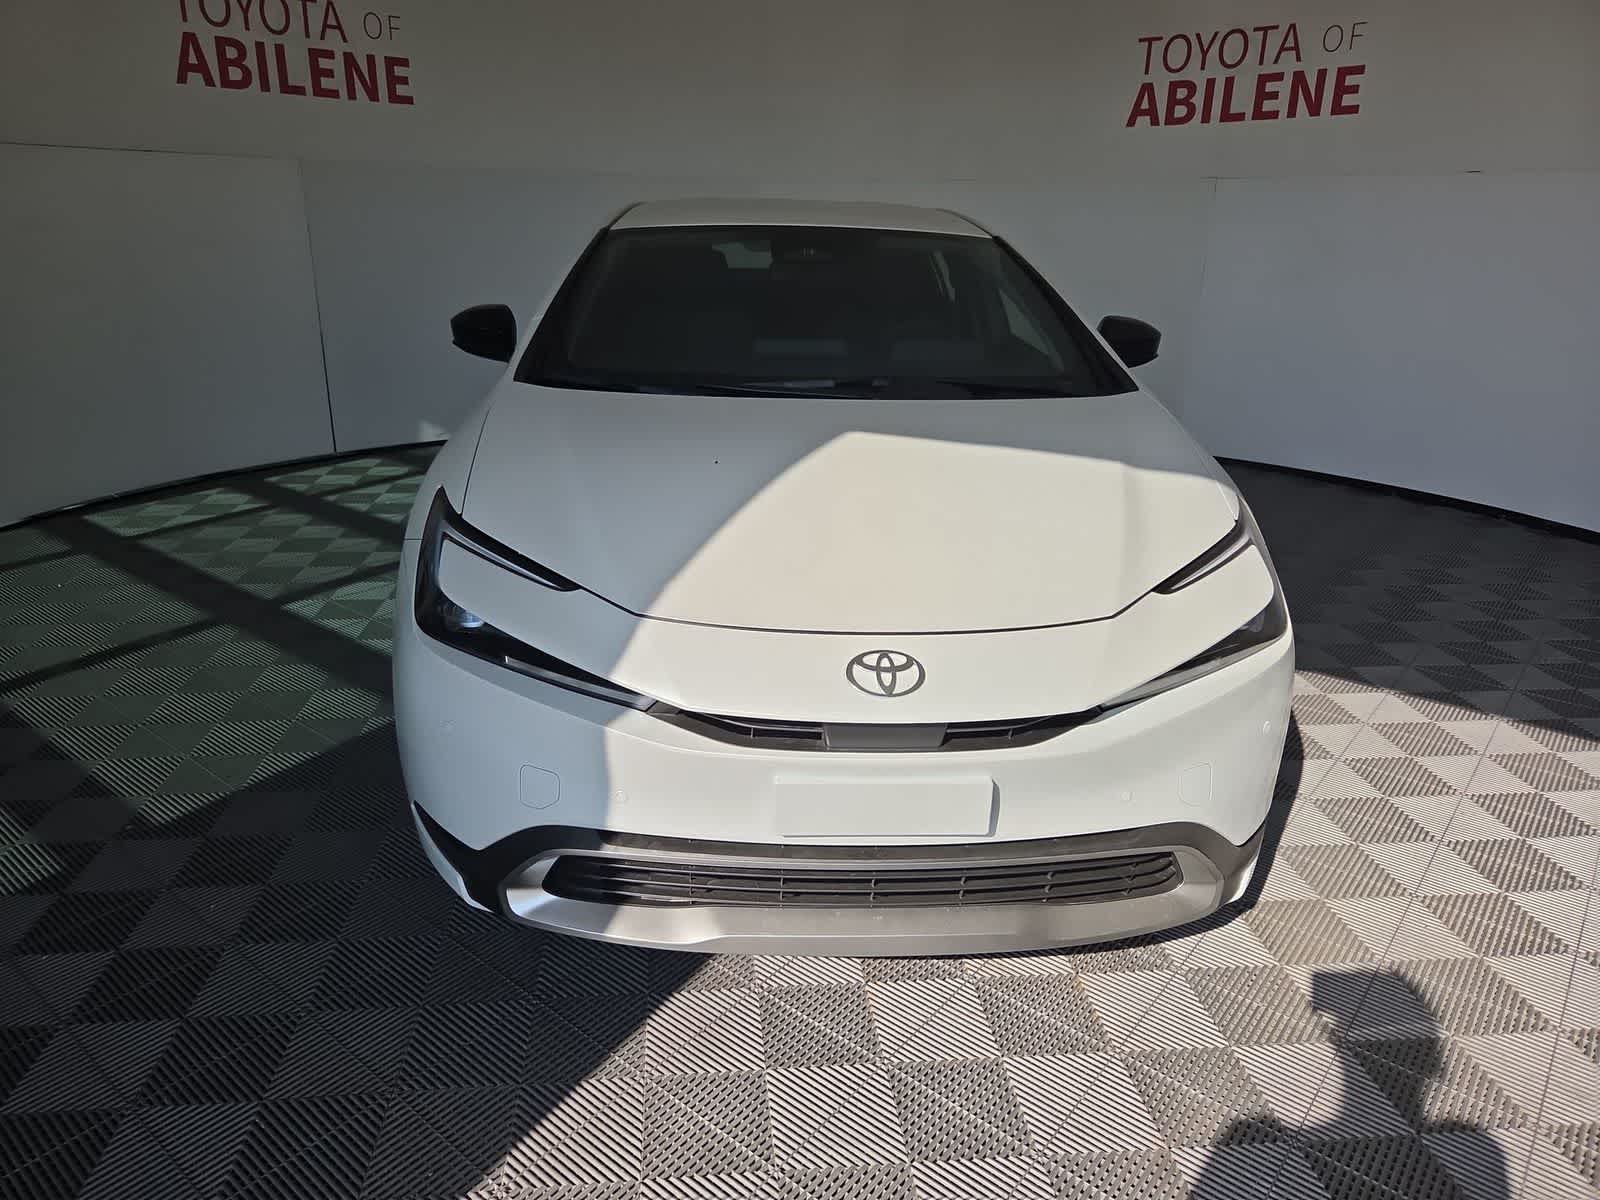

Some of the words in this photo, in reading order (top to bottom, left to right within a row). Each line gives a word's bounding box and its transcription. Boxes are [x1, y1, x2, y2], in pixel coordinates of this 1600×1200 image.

[363, 11, 401, 40] OF
[1138, 23, 1302, 75] TOYOTA
[1322, 21, 1368, 53] OF
[176, 31, 414, 105] ABILENE
[1125, 64, 1366, 128] ABILENE
